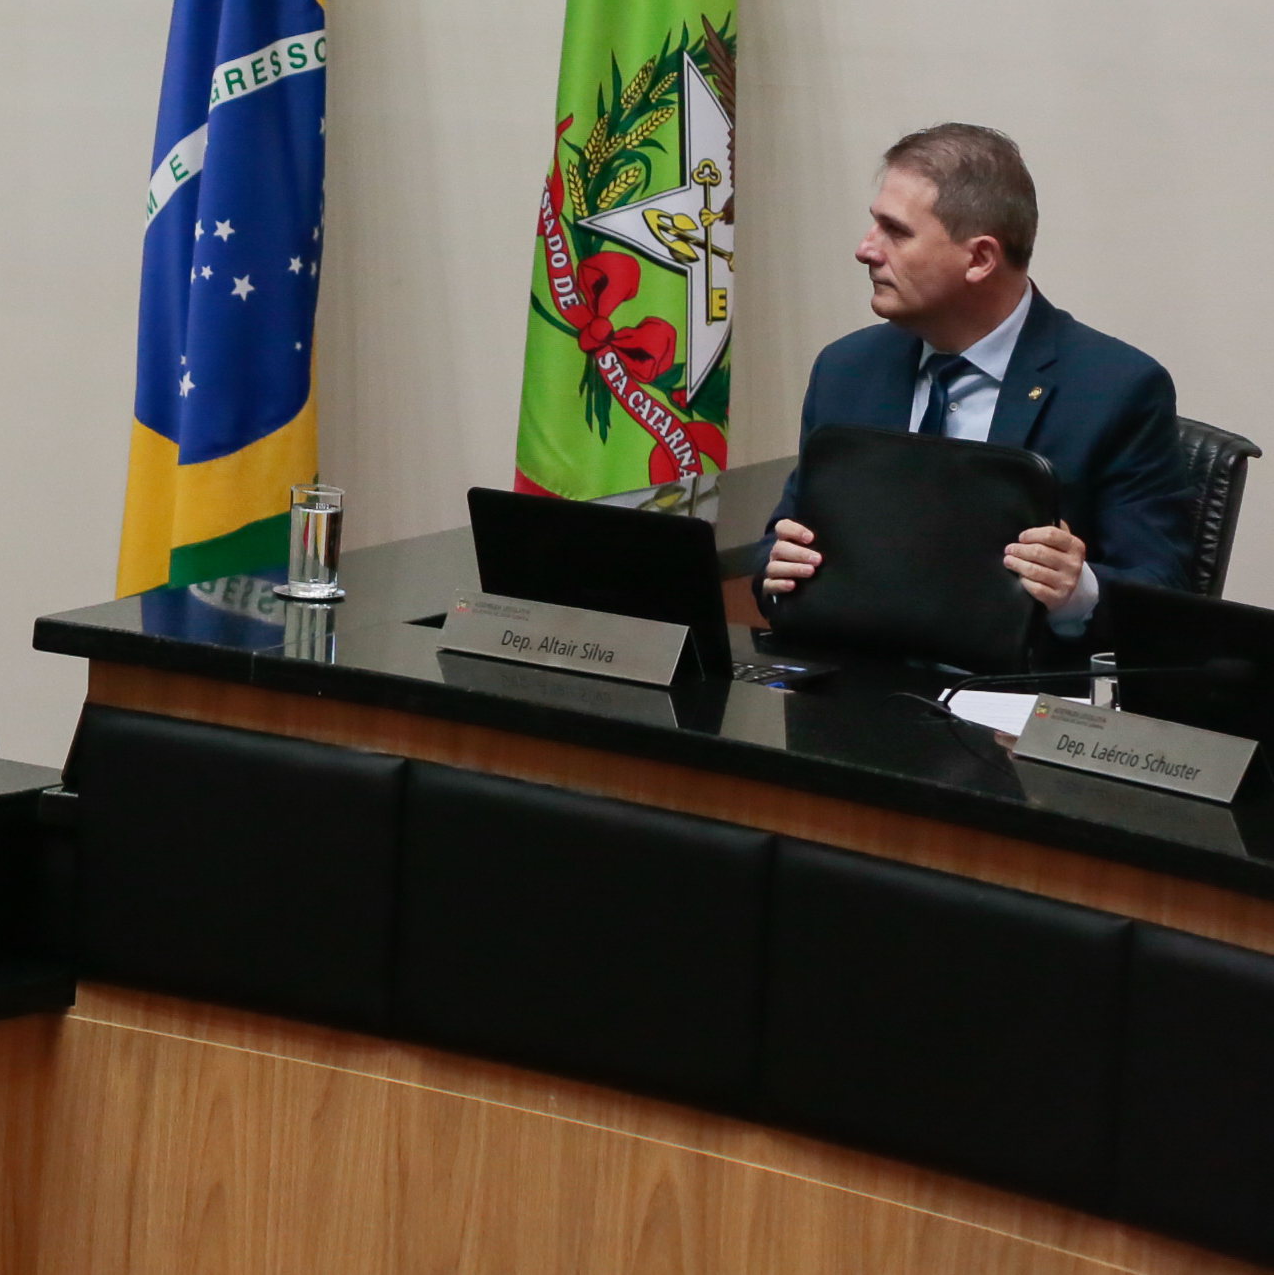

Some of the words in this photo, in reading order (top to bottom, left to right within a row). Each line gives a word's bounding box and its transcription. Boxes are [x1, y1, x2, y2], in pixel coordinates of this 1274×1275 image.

[540, 183, 569, 269] STADO
[553, 276, 580, 310] DE
[598, 351, 627, 400] STA.
[627, 390, 698, 481] CATARINA
[501, 629, 533, 653] Dep.
[537, 635, 579, 659] Altair
[580, 642, 615, 664] Silva
[1056, 733, 1086, 759] Dep.
[1091, 740, 1141, 768] Laércio
[1141, 753, 1202, 782] Schuster
